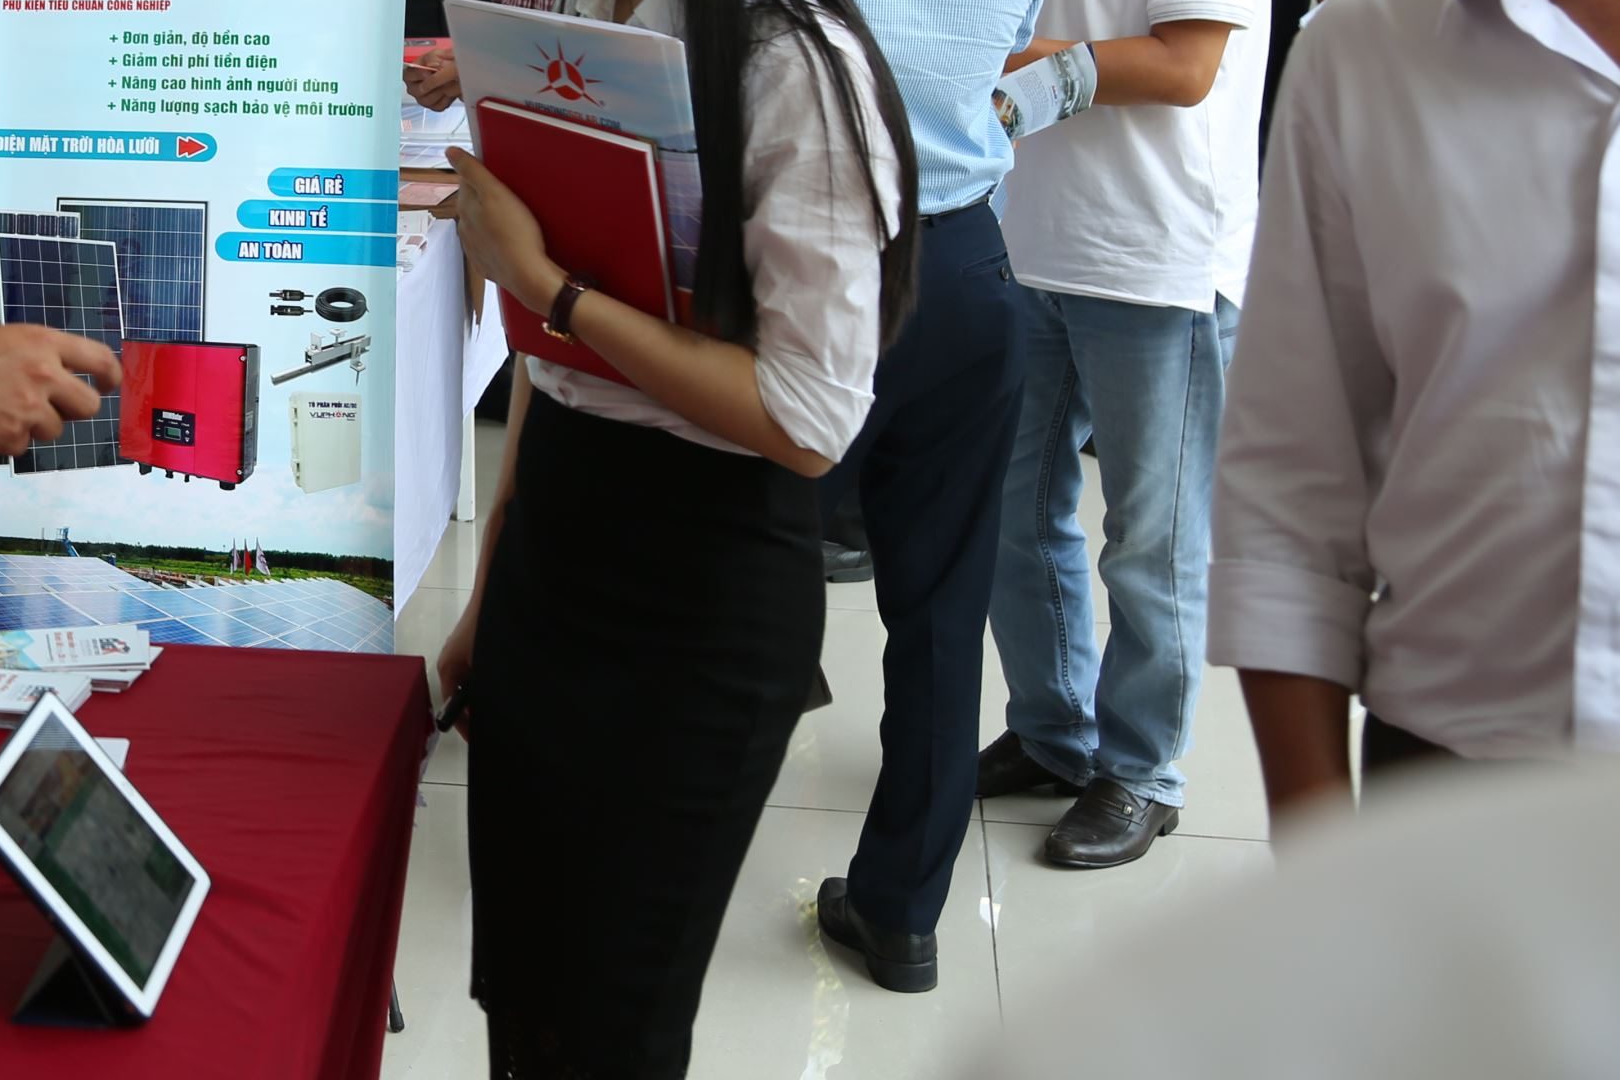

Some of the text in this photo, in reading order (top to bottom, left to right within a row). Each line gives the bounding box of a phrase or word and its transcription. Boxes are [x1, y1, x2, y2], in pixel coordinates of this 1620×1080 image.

[244, 34, 270, 46] cao
[162, 54, 183, 68] chi
[161, 78, 187, 90] cao
[30, 134, 58, 156] MẶT
[61, 135, 93, 153] TRỜI
[97, 135, 125, 154] HÒA
[129, 136, 160, 155] LƯỚI
[294, 174, 321, 194] GIÁ
[269, 206, 328, 227] KINH TẾ
[238, 240, 303, 259] AN TOÀN
